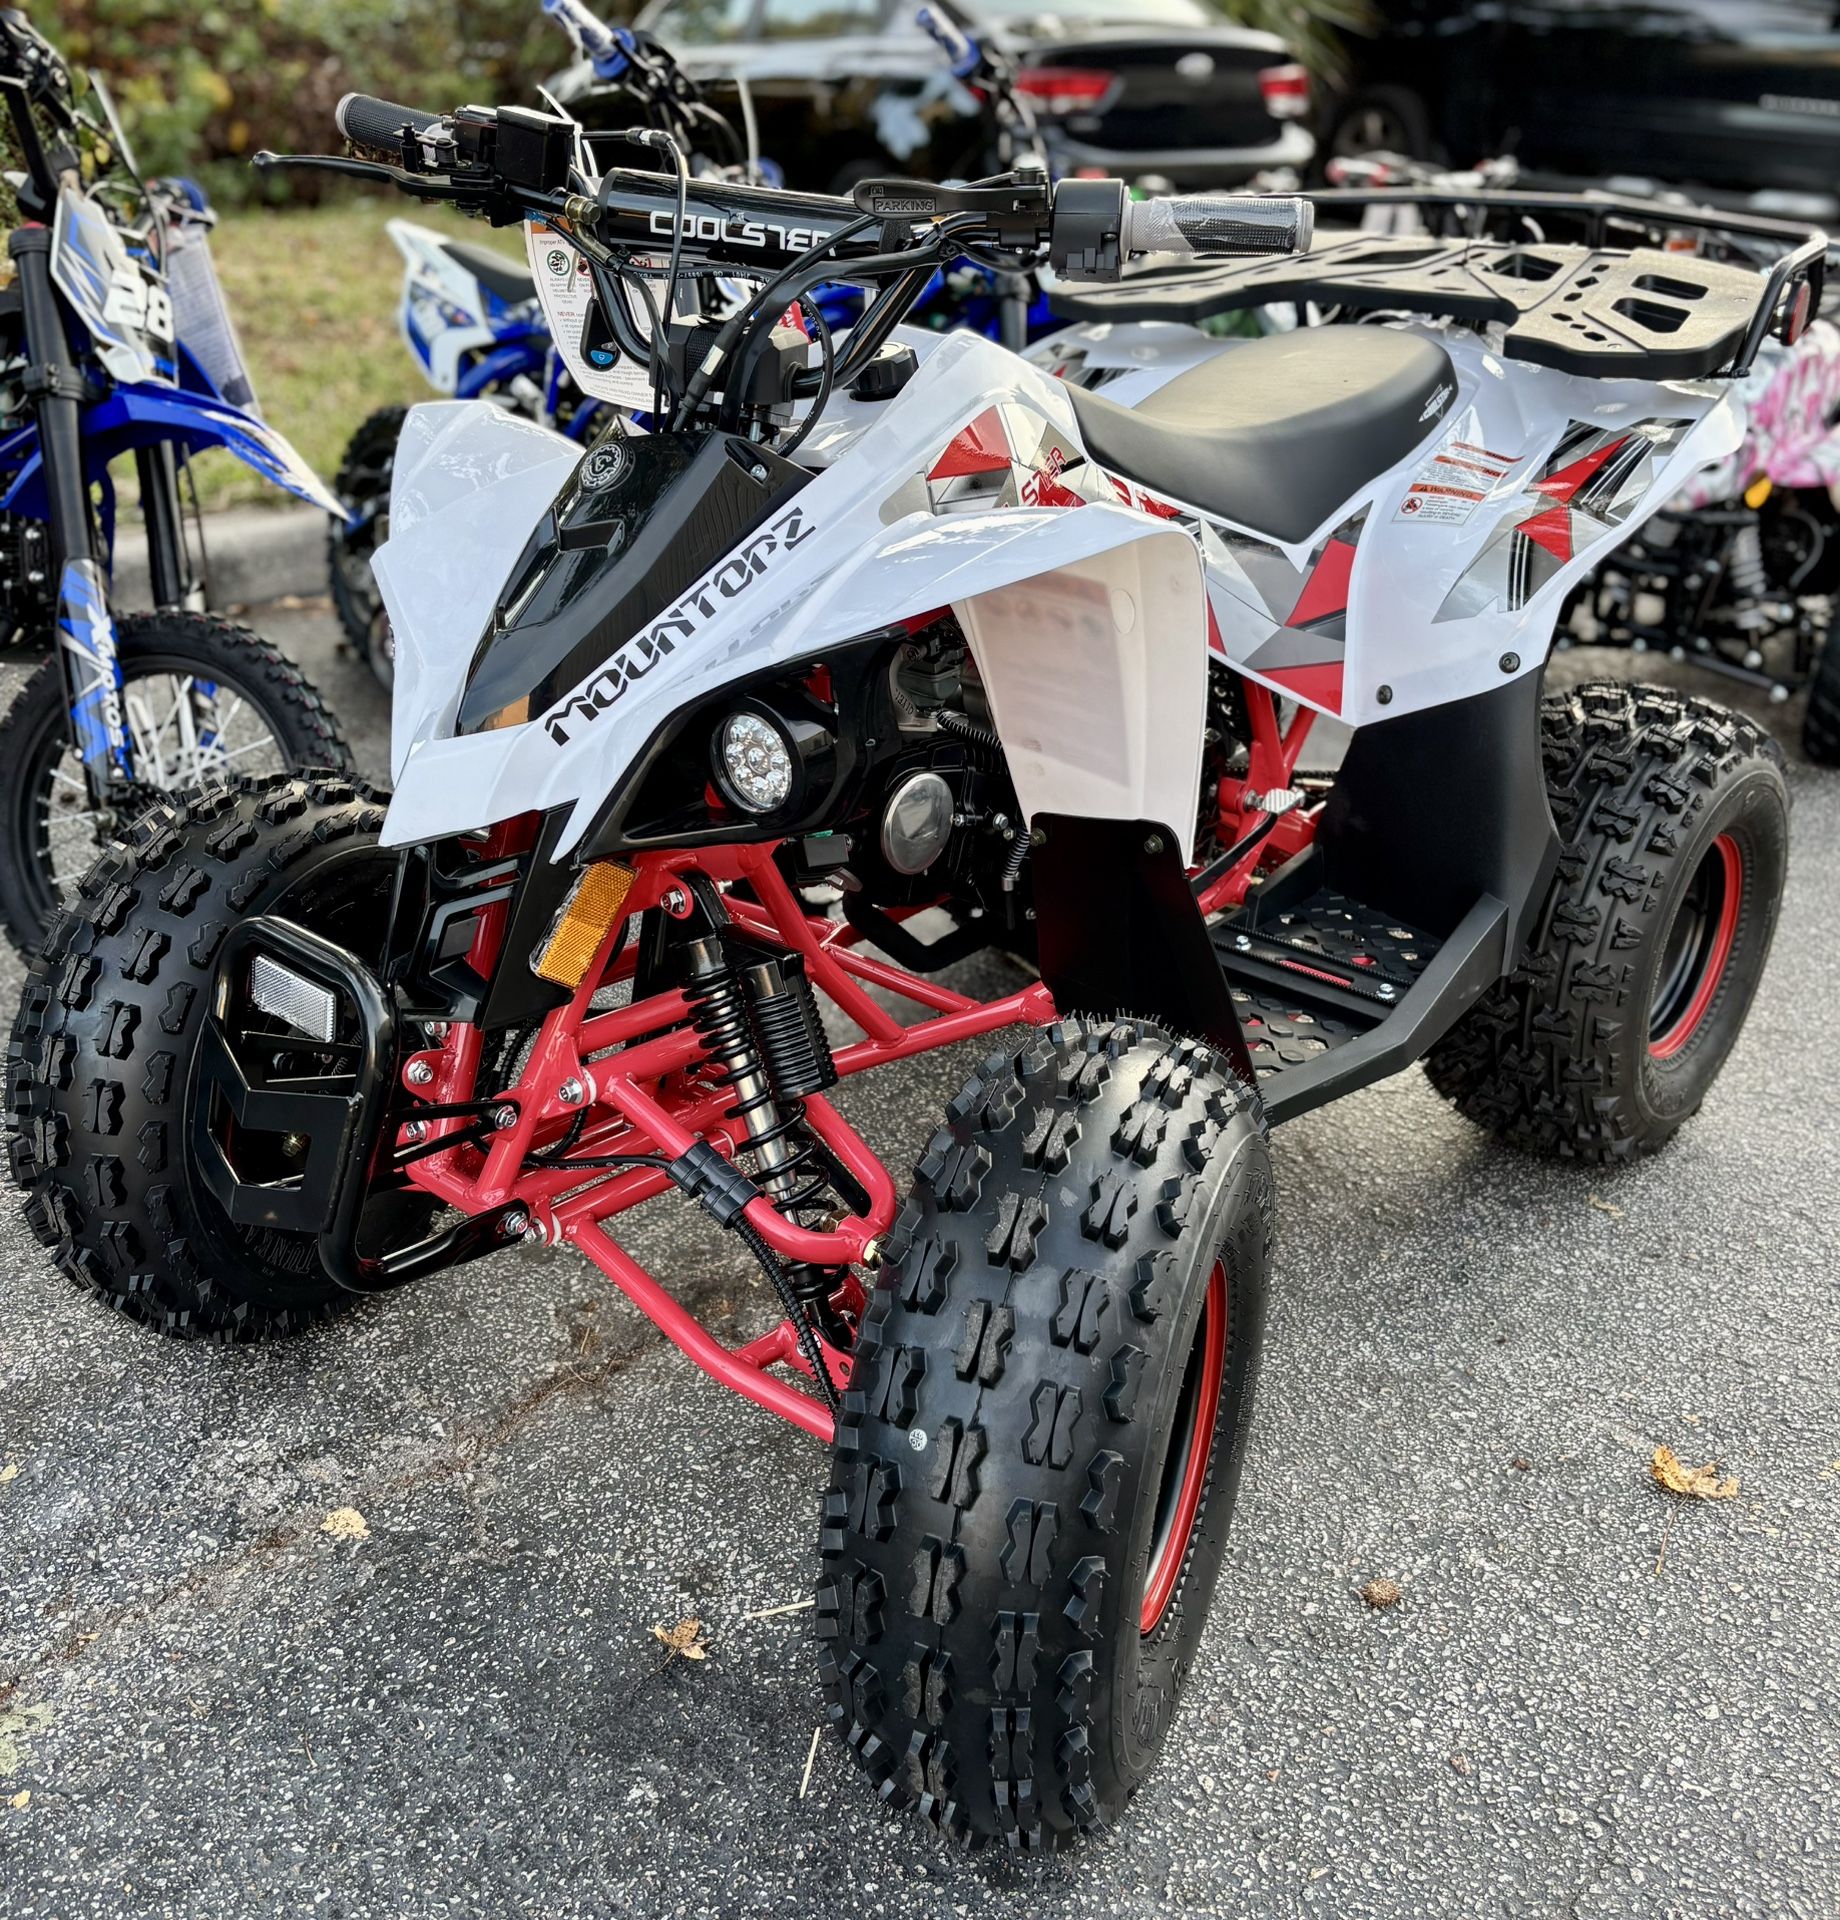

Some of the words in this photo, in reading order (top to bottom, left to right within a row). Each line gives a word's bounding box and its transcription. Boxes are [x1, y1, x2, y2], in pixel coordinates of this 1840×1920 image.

[876, 200, 934, 211] PARKING
[1429, 485, 1474, 498] WARNING
[545, 507, 817, 747] MOUNTOPZ
